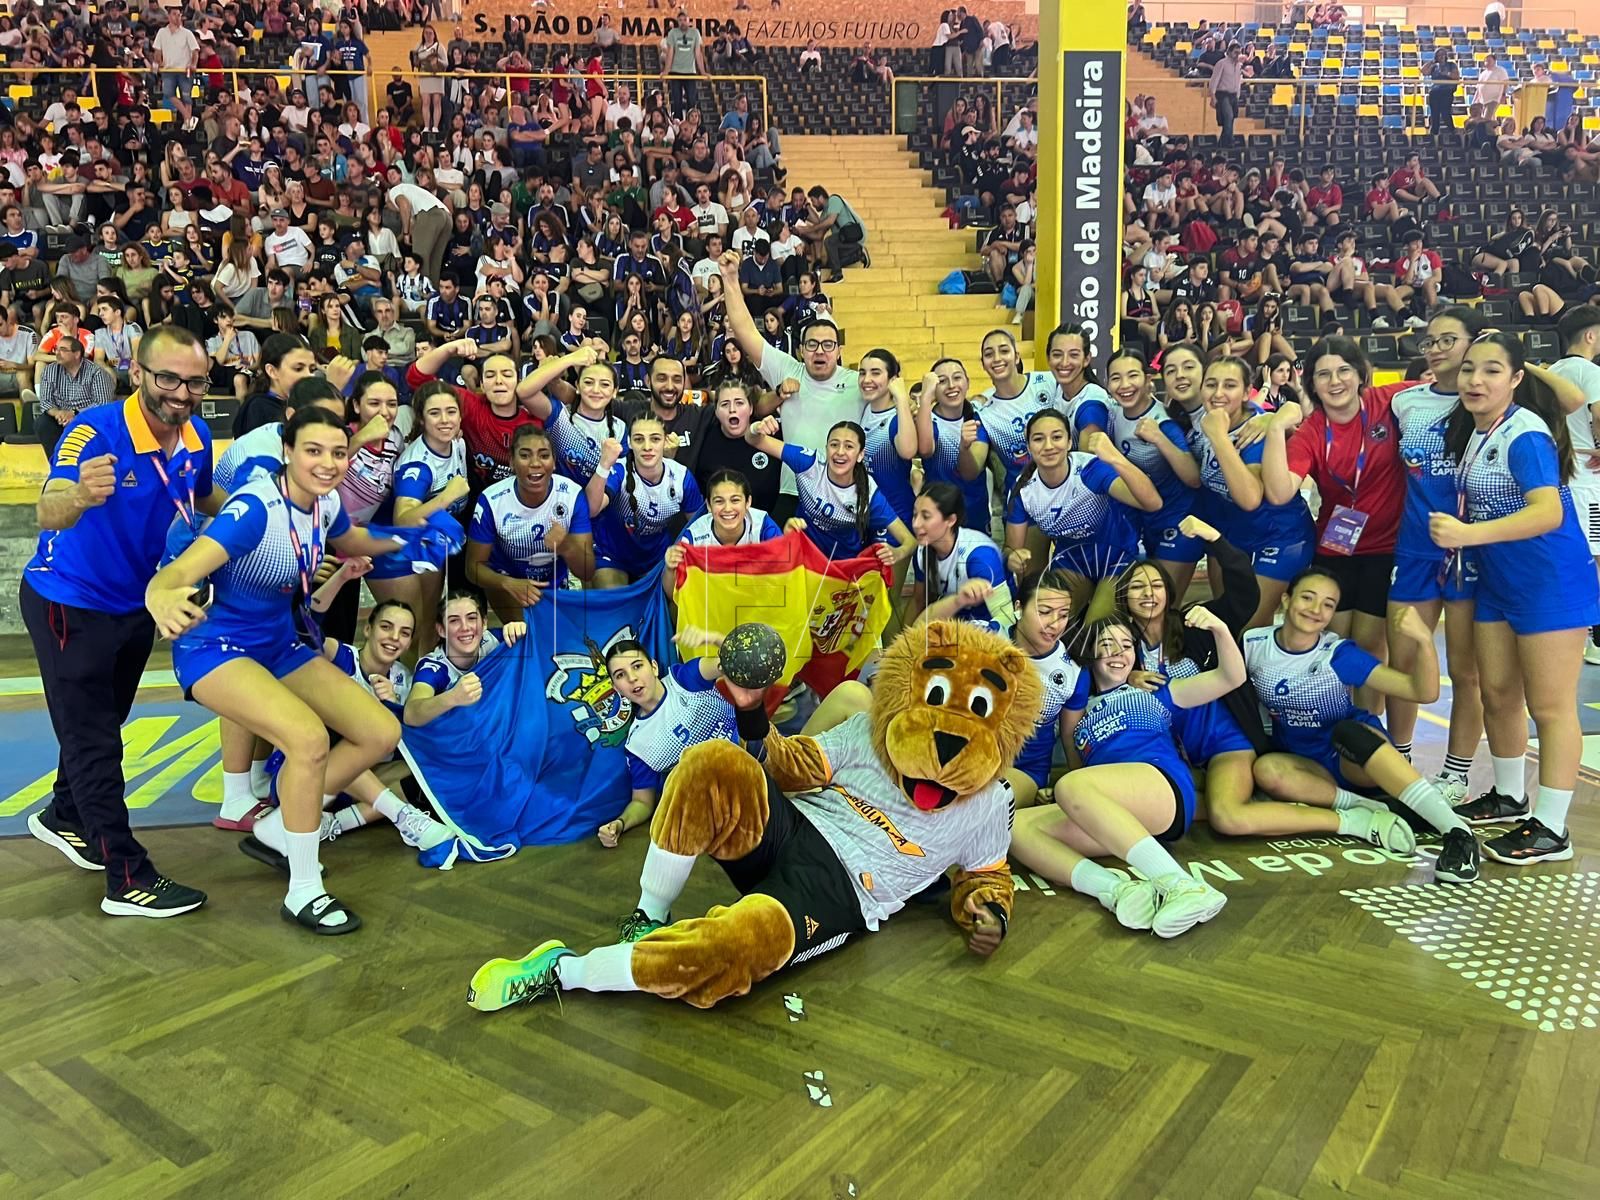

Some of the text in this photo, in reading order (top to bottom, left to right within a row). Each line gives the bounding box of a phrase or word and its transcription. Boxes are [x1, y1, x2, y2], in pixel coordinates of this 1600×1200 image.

[474, 13, 497, 35] S.
[621, 17, 736, 38] MADIRA
[745, 20, 920, 40] FAZEMOS FUTURO
[1074, 60, 1103, 209] Madeira
[1073, 221, 1100, 265] da
[646, 502, 658, 518] 5
[814, 496, 835, 518] 10
[1051, 506, 1063, 522] 7
[530, 524, 545, 541] 2
[1274, 678, 1290, 696] 6
[1092, 710, 1126, 731] MELILLA
[1093, 720, 1121, 738] SPORT
[673, 723, 691, 744] 5
[1248, 852, 1334, 876] da
